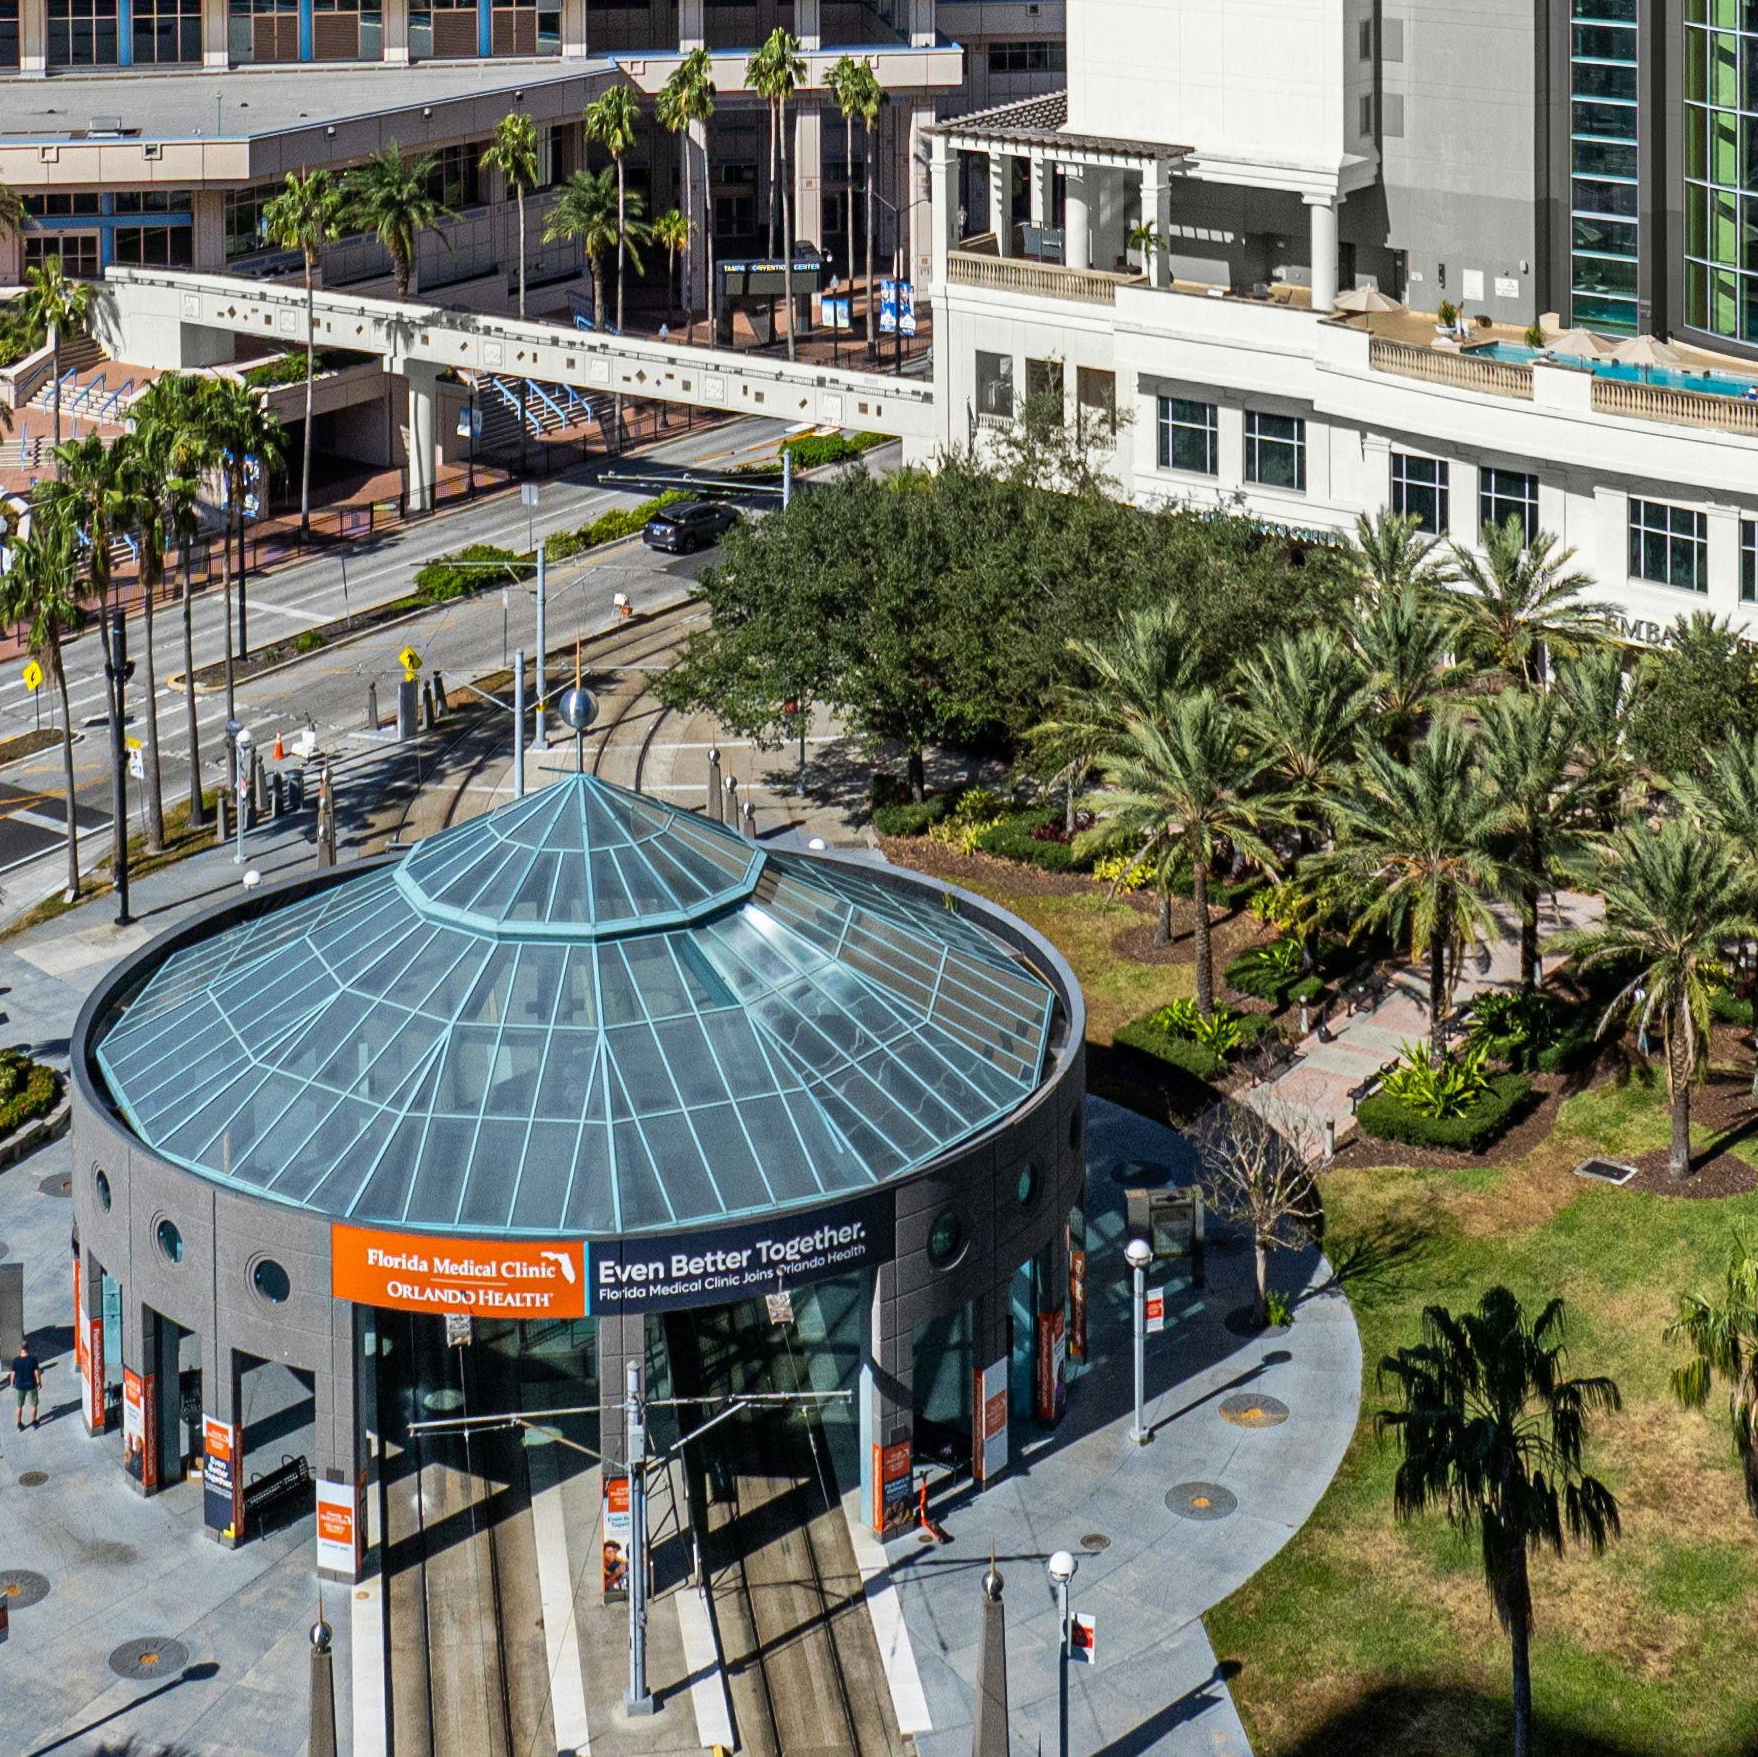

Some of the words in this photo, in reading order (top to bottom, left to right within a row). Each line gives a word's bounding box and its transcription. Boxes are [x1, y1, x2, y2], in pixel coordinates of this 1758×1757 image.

[793, 262, 821, 271] CENTER
[367, 1248, 429, 1273] Florida
[433, 1257, 497, 1278] Medical
[500, 1261, 556, 1279] Clinic
[599, 1260, 665, 1284] Even
[671, 1249, 752, 1277] Better
[755, 1221, 867, 1260] Together.
[599, 1286, 646, 1301] Florida
[649, 1279, 702, 1297] Medical
[704, 1274, 740, 1289] Clinic
[742, 1268, 773, 1284] Joins
[827, 1243, 866, 1263] Health
[386, 1281, 476, 1305] ORLANDO
